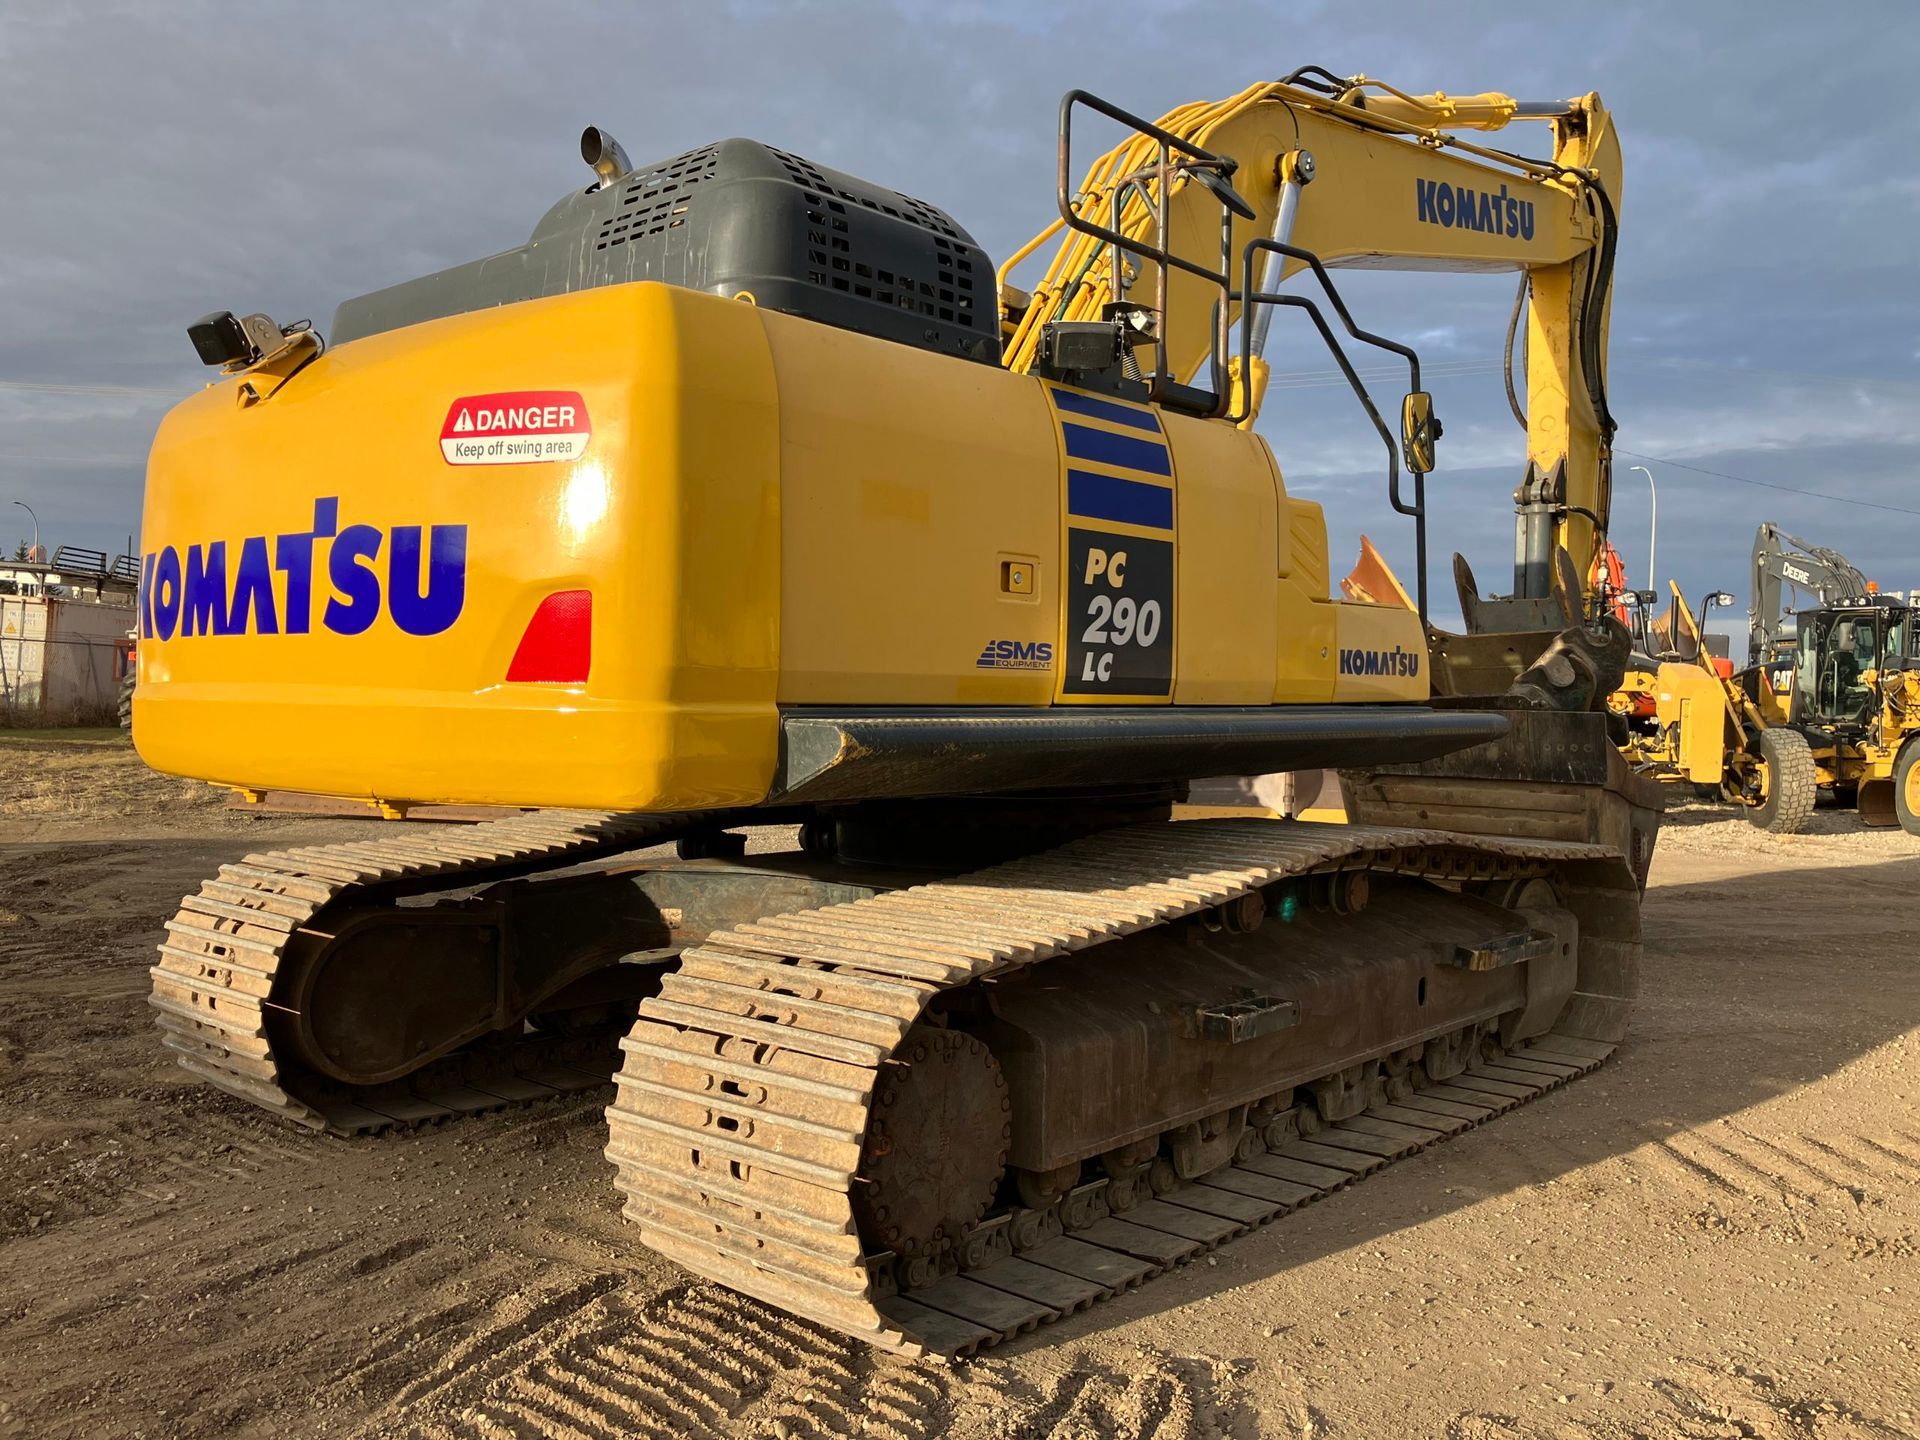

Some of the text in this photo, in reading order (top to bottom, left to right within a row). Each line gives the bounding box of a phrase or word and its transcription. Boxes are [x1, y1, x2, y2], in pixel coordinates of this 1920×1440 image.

[1417, 178, 1534, 241] KOMATSU
[476, 406, 575, 430] DANGER
[456, 440, 572, 459] Keep off swing area
[138, 496, 467, 642] KOMATSU
[1084, 547, 1127, 588] PC
[1782, 561, 1810, 585] DEERE
[1081, 594, 1161, 647] 290
[995, 660, 1052, 668] EQUIPMENT
[996, 640, 1053, 661] SMS
[1340, 645, 1418, 677] KOMATSU
[1081, 651, 1114, 682] LC
[1773, 670, 1793, 691] CAT
